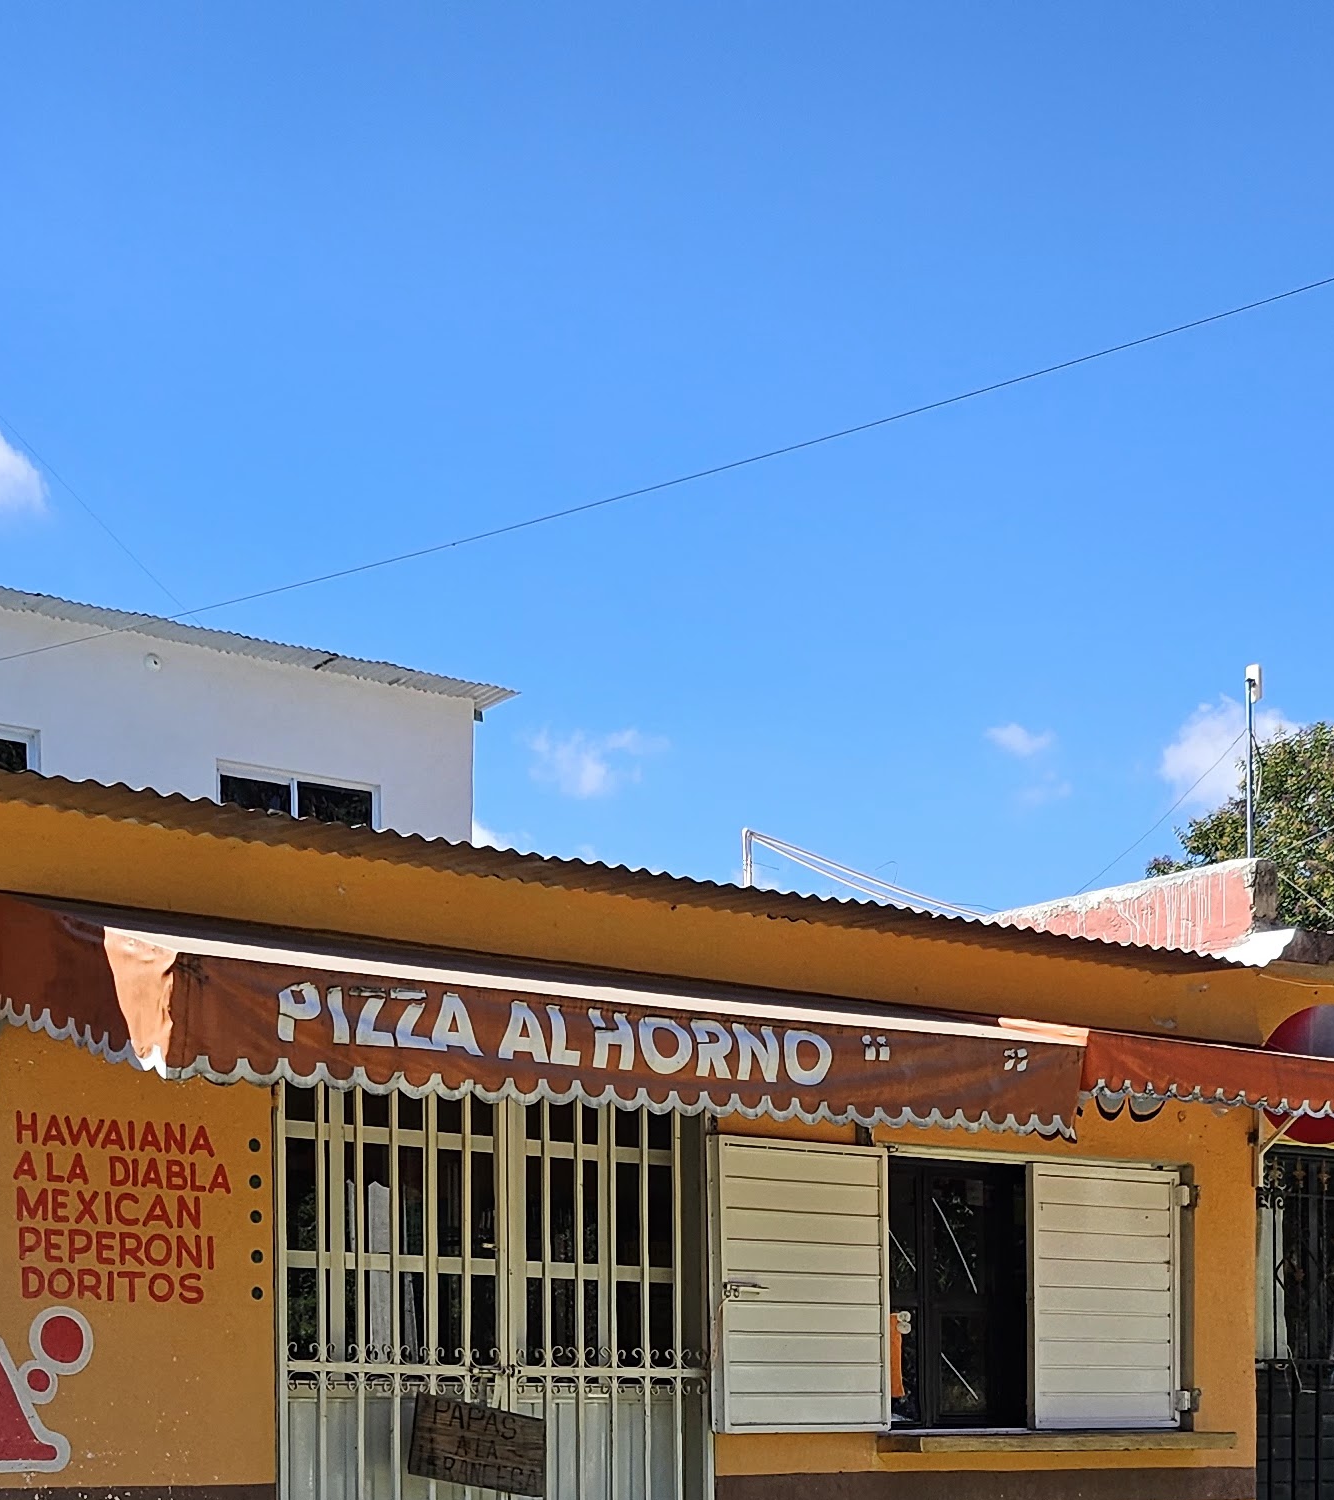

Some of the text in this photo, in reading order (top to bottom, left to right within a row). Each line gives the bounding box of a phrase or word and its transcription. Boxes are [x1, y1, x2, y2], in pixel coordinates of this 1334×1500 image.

[278, 981, 832, 1086] PIZZA AL HORNO
[16, 1110, 215, 1158] HAWAIANA
[13, 1151, 231, 1194] A LA DIABLA
[16, 1186, 201, 1229] MEXICAN
[18, 1226, 214, 1270] PEPERONI
[21, 1266, 204, 1304] DORITOS
[433, 1400, 516, 1440] PAPAS
